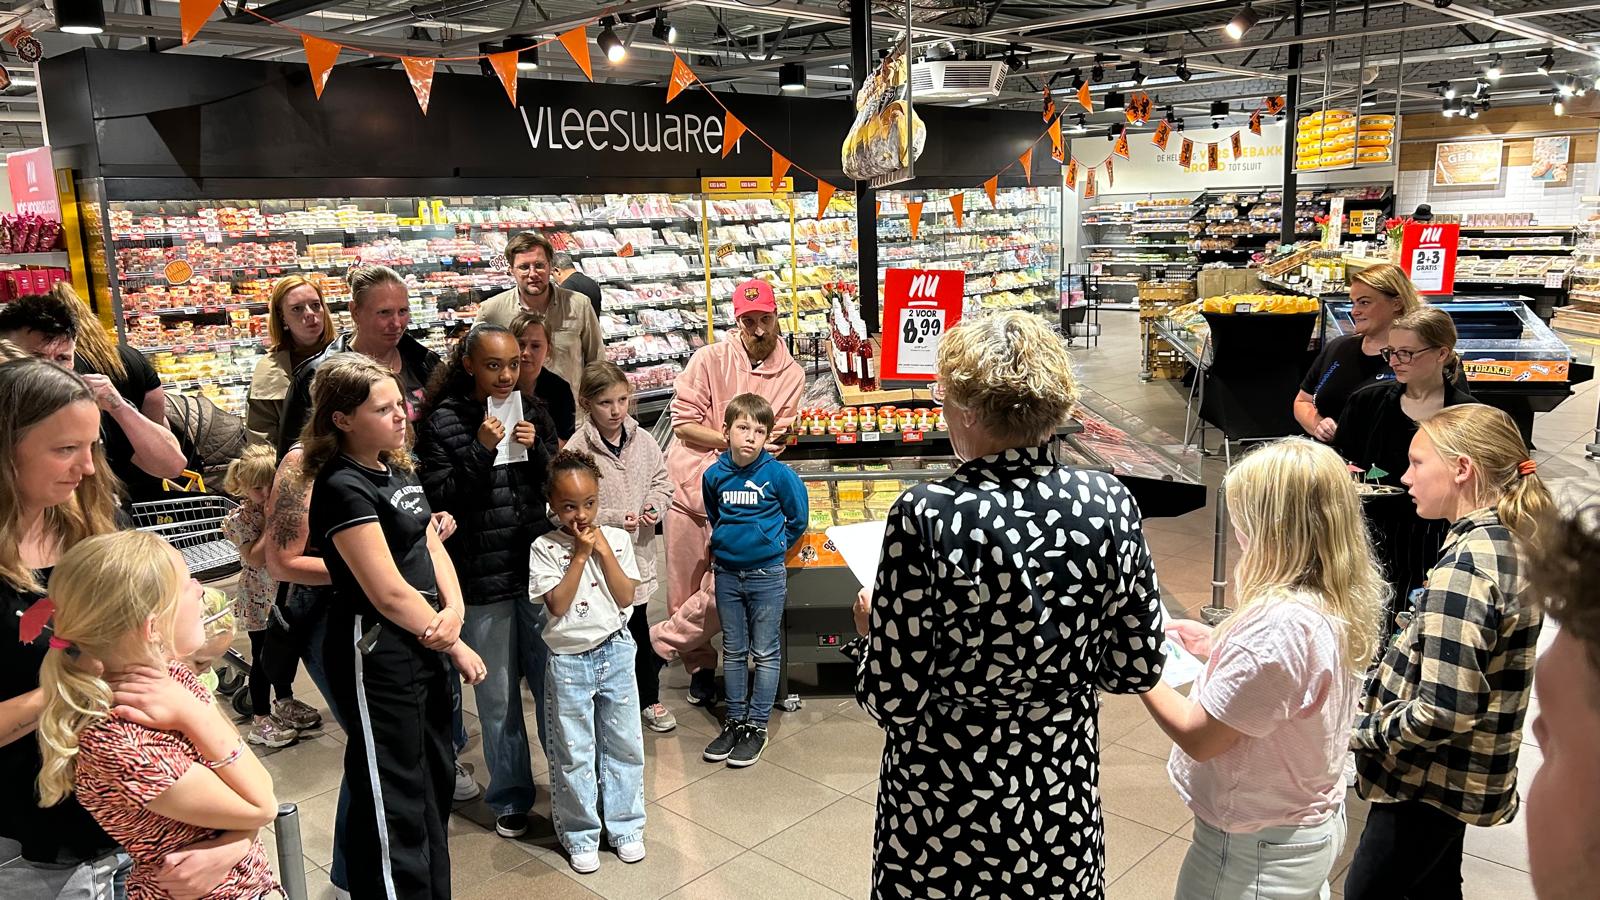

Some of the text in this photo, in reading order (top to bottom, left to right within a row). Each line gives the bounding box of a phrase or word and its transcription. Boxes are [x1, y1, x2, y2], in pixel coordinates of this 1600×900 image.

[1229, 163, 1240, 171] TOT
[1242, 162, 1262, 171] SLUIT
[1416, 251, 1440, 265] 2+3
[908, 309, 937, 318] 2 VOOR
[722, 490, 758, 504] PUMA
